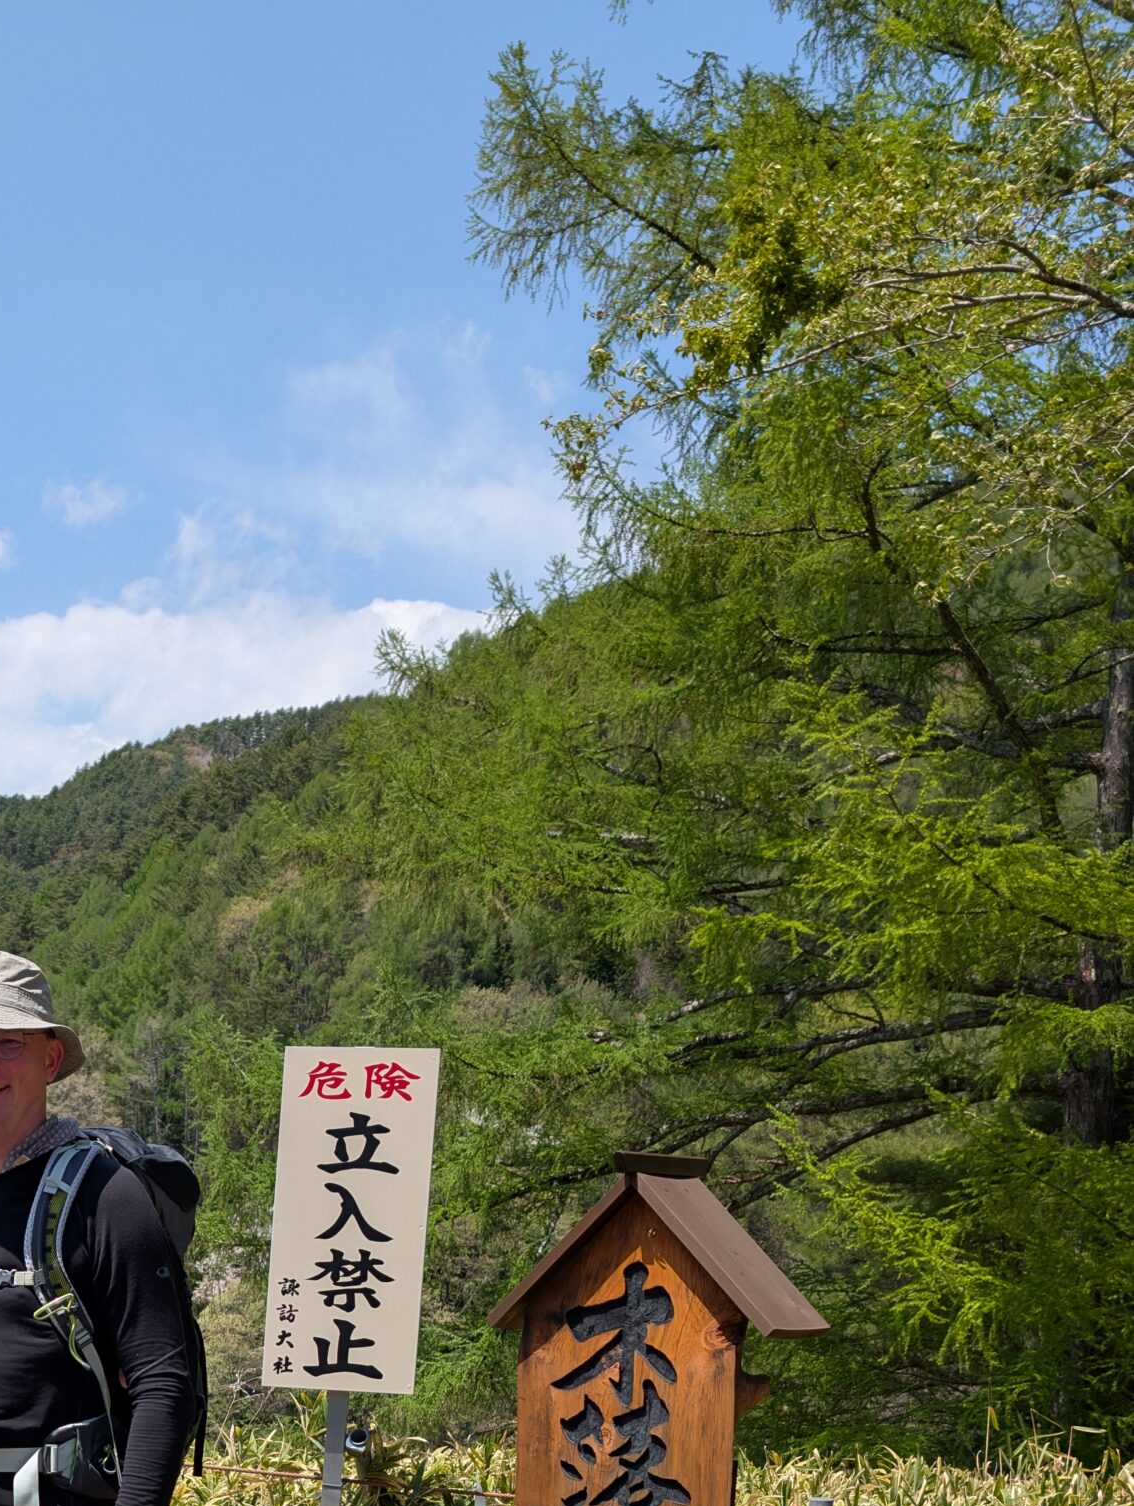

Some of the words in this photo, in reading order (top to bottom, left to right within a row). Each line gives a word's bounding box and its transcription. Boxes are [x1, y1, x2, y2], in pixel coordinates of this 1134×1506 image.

[298, 1061, 421, 1101] 危険
[302, 1112, 400, 1380] 立入禁止
[273, 1277, 300, 1375] 諏訪大社
